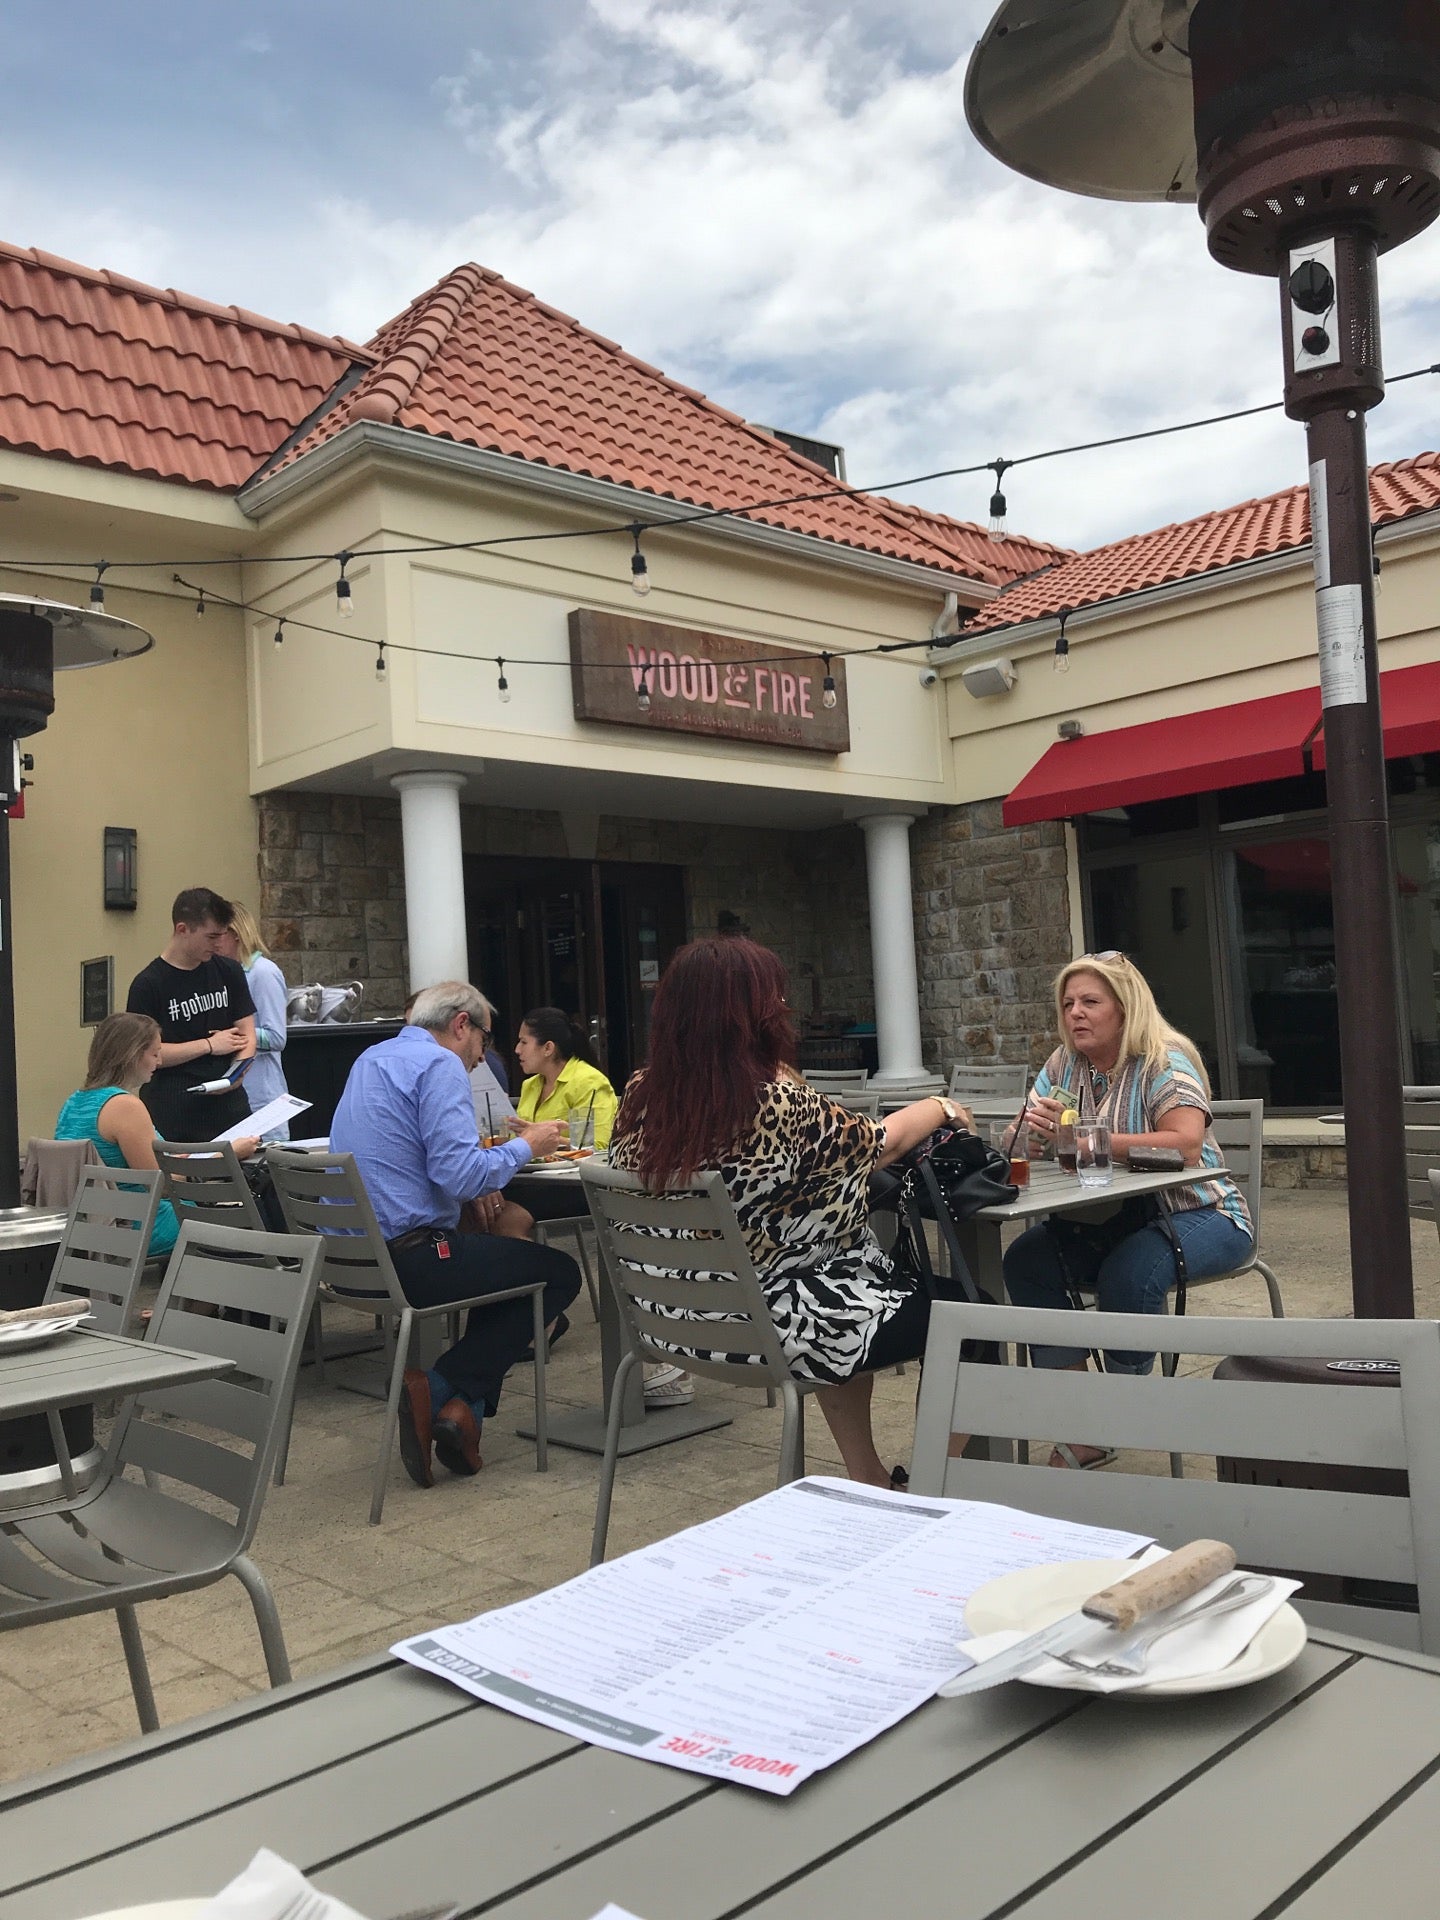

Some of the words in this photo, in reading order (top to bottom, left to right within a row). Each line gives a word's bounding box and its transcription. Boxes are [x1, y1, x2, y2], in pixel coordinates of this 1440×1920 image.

[627, 643, 718, 704] WOOD
[723, 664, 751, 708] &
[754, 667, 815, 719] FIRE
[424, 1648, 491, 1680] LUNCH
[658, 1736, 716, 1758] FIRE
[729, 1754, 799, 1777] WOOD
